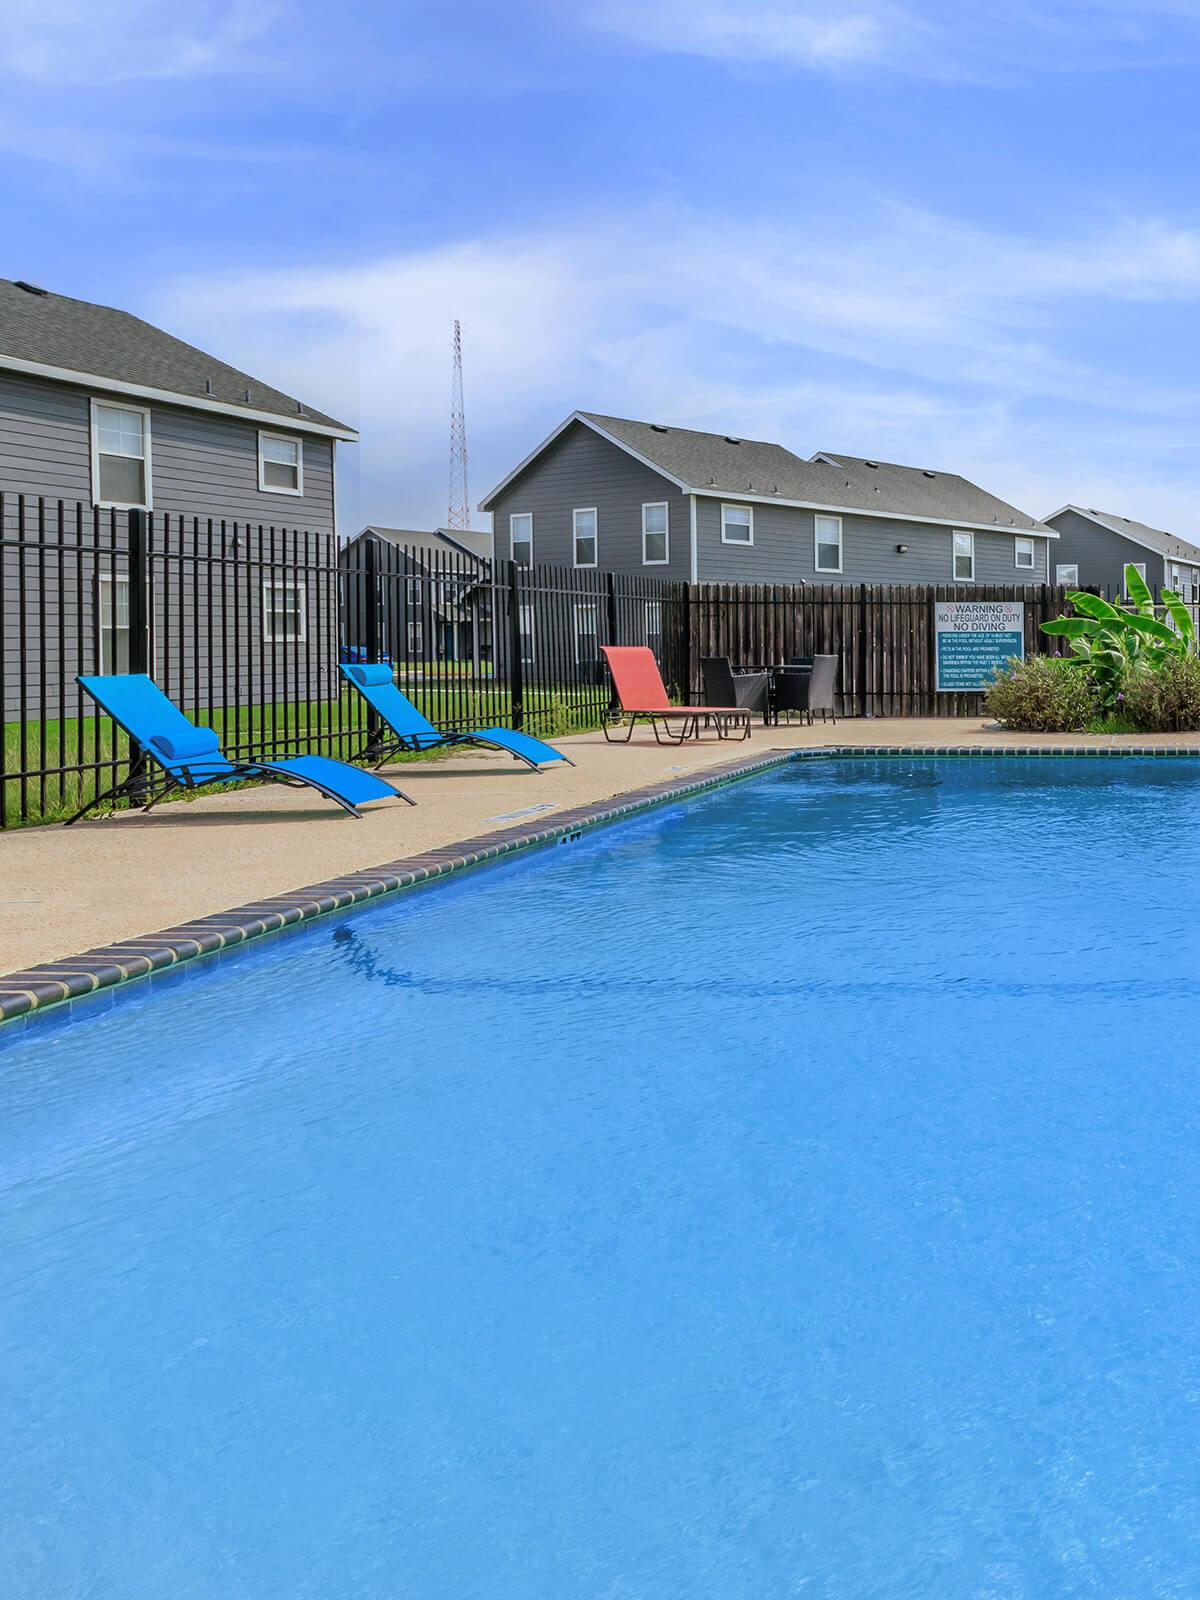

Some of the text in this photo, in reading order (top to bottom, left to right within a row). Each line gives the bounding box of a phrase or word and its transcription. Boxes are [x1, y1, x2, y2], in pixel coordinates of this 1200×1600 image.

[955, 605, 1003, 613] WARNING
[938, 614, 1020, 622] NO LIFEGUARD ON DUTY
[953, 622, 1006, 631] NO DIVING
